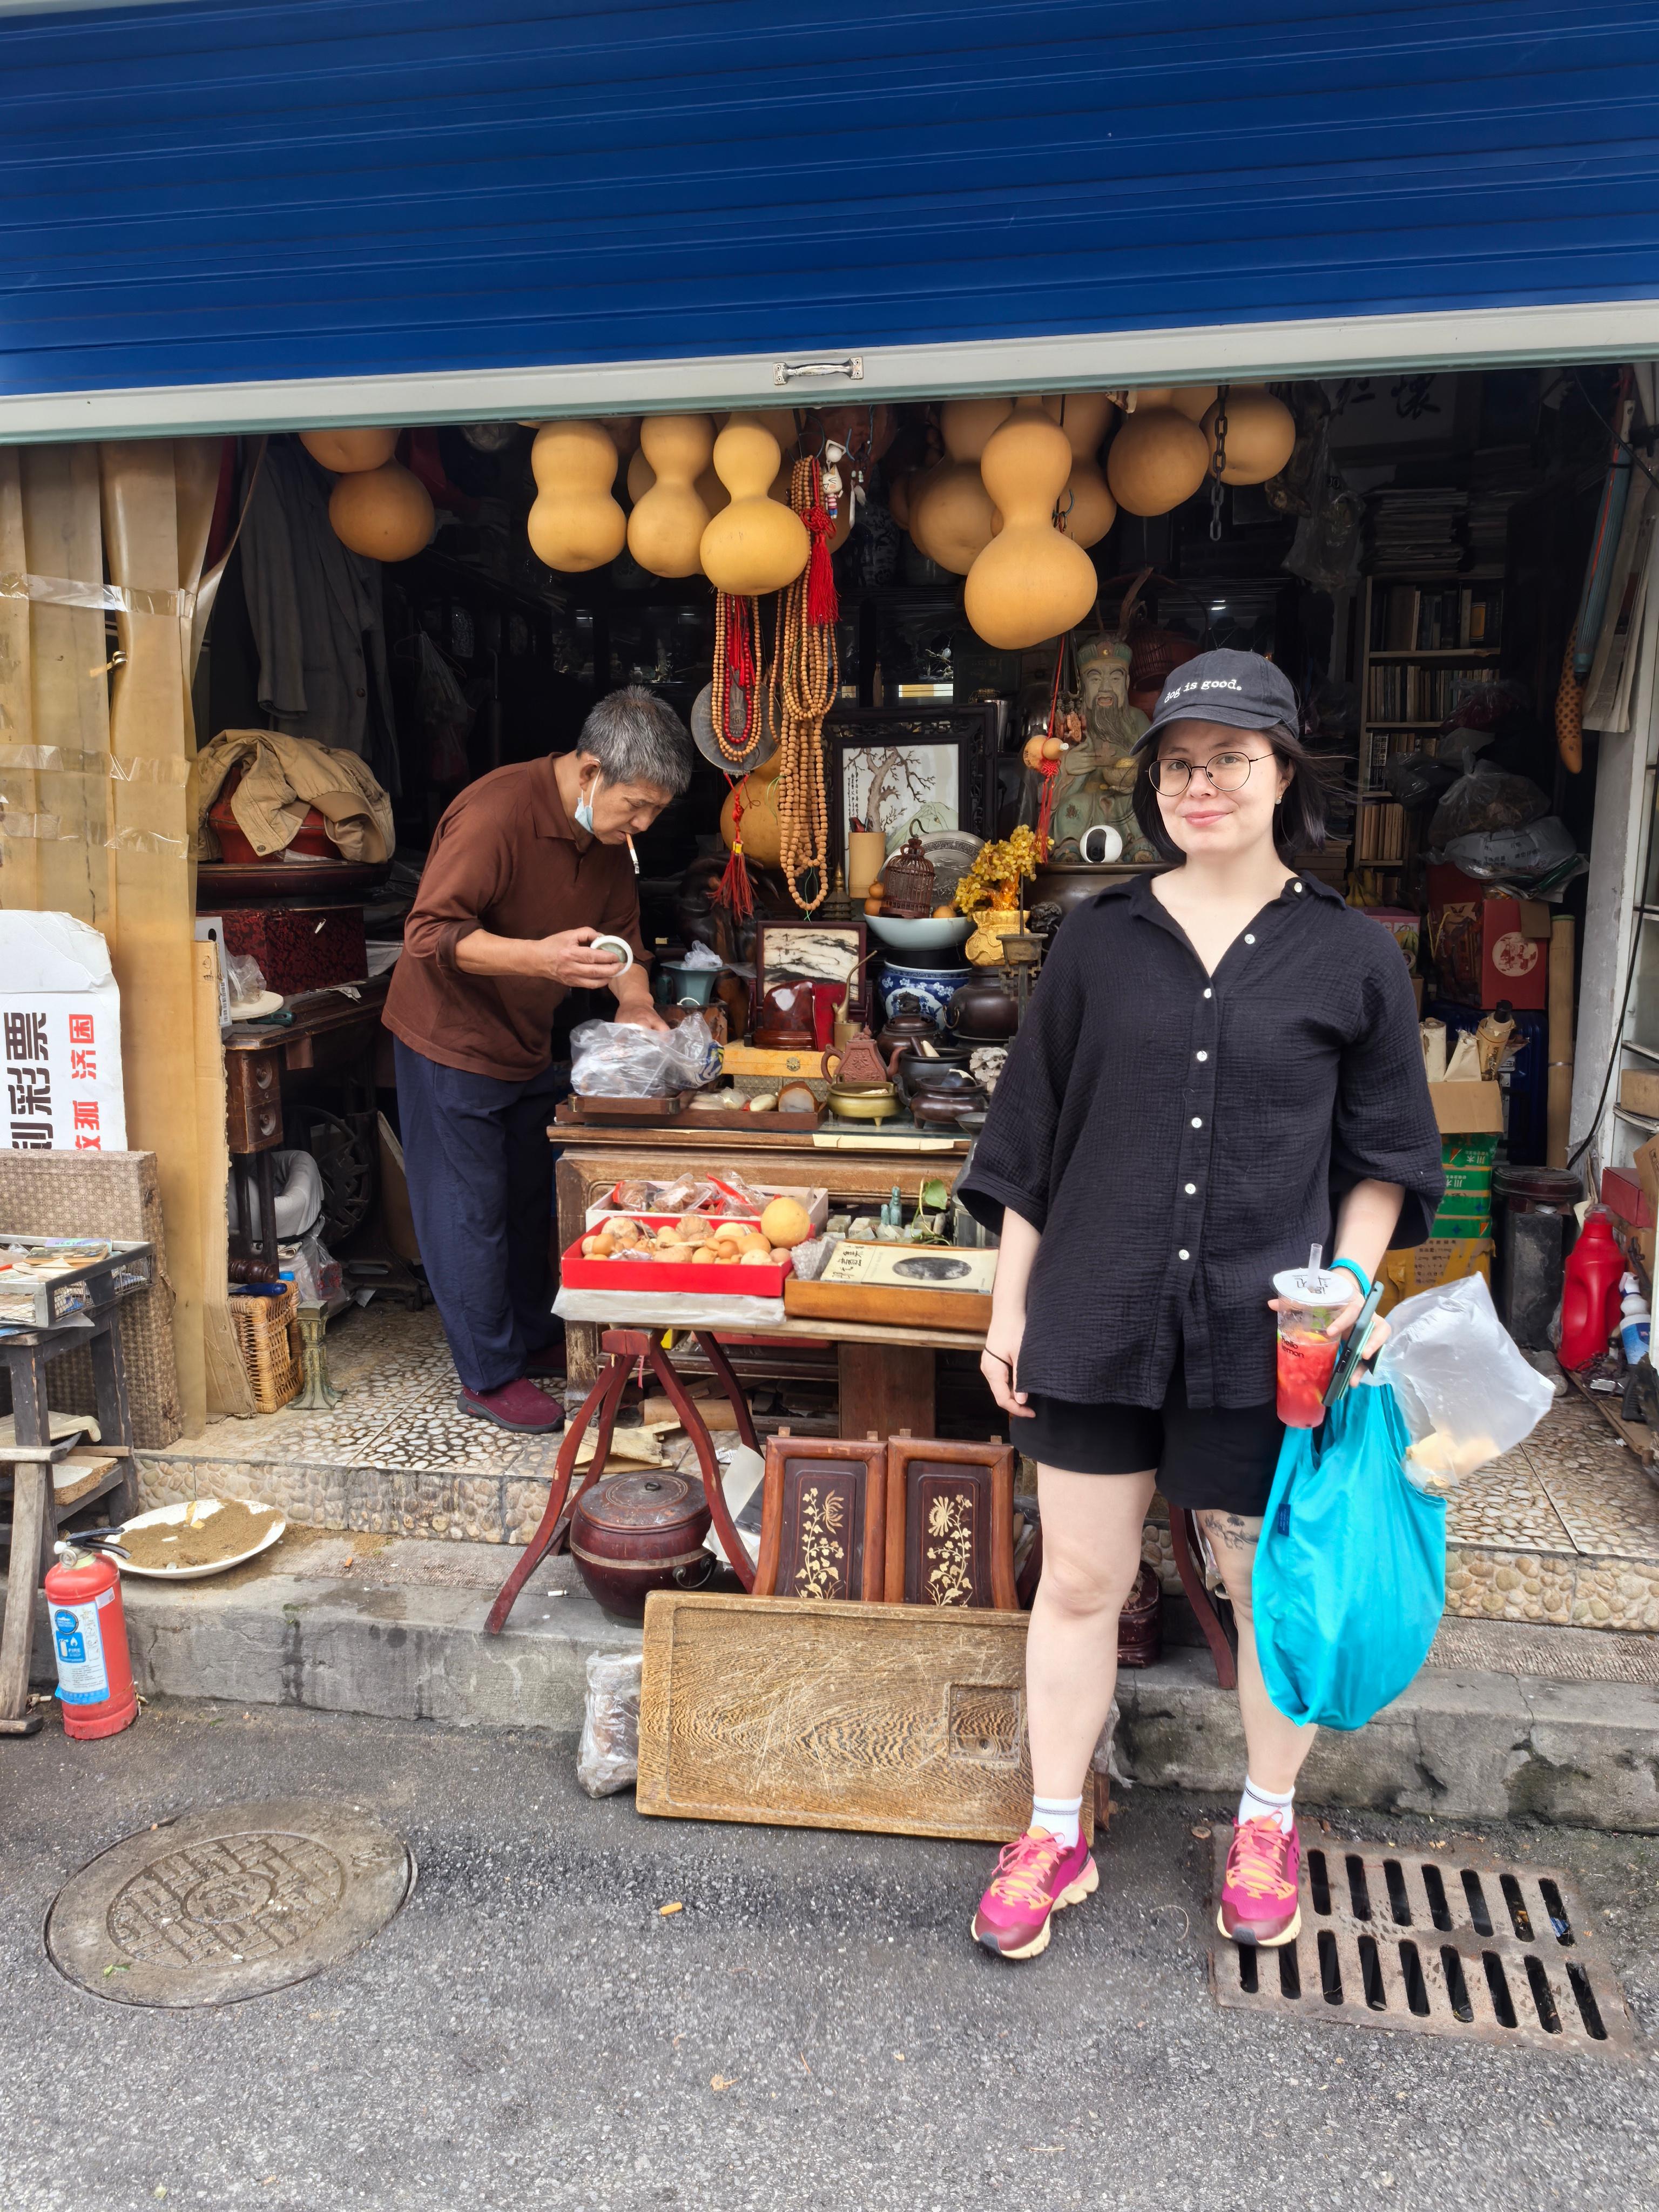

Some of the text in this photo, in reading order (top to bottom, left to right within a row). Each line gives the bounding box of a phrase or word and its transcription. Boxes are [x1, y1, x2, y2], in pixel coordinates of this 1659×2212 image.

[1164, 679, 1242, 703] dog is good.
[69, 1014, 97, 1080] 济困
[1282, 1335, 1298, 1349] hello
[1282, 1343, 1305, 1359] lemon
